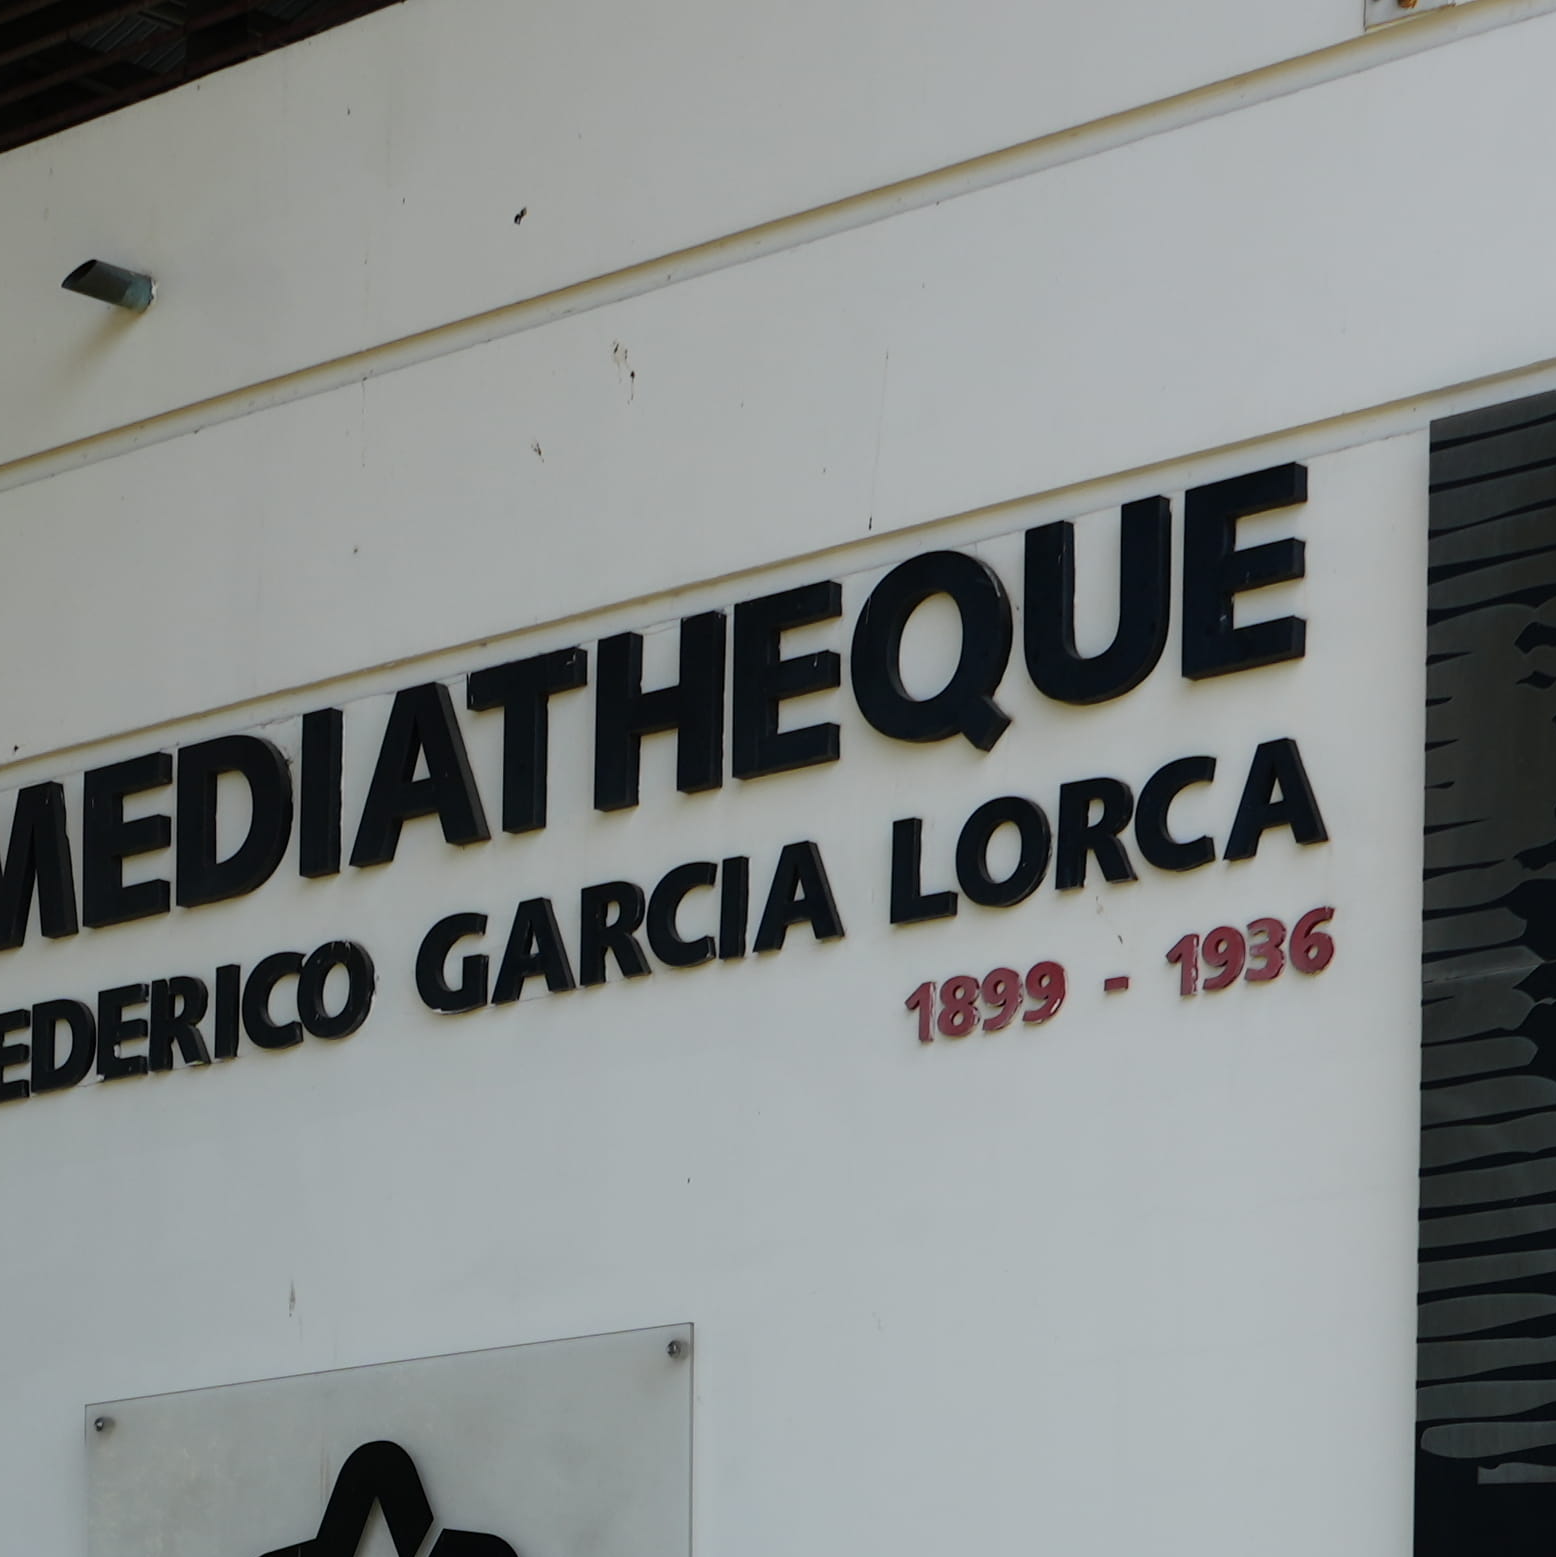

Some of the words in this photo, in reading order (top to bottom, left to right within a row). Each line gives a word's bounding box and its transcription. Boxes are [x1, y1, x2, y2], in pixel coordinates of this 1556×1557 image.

[416, 841, 846, 1015] GARCIA
[890, 738, 1329, 925] LORCA
[904, 962, 1067, 1042] 1899
[1165, 906, 1336, 994] 1936
